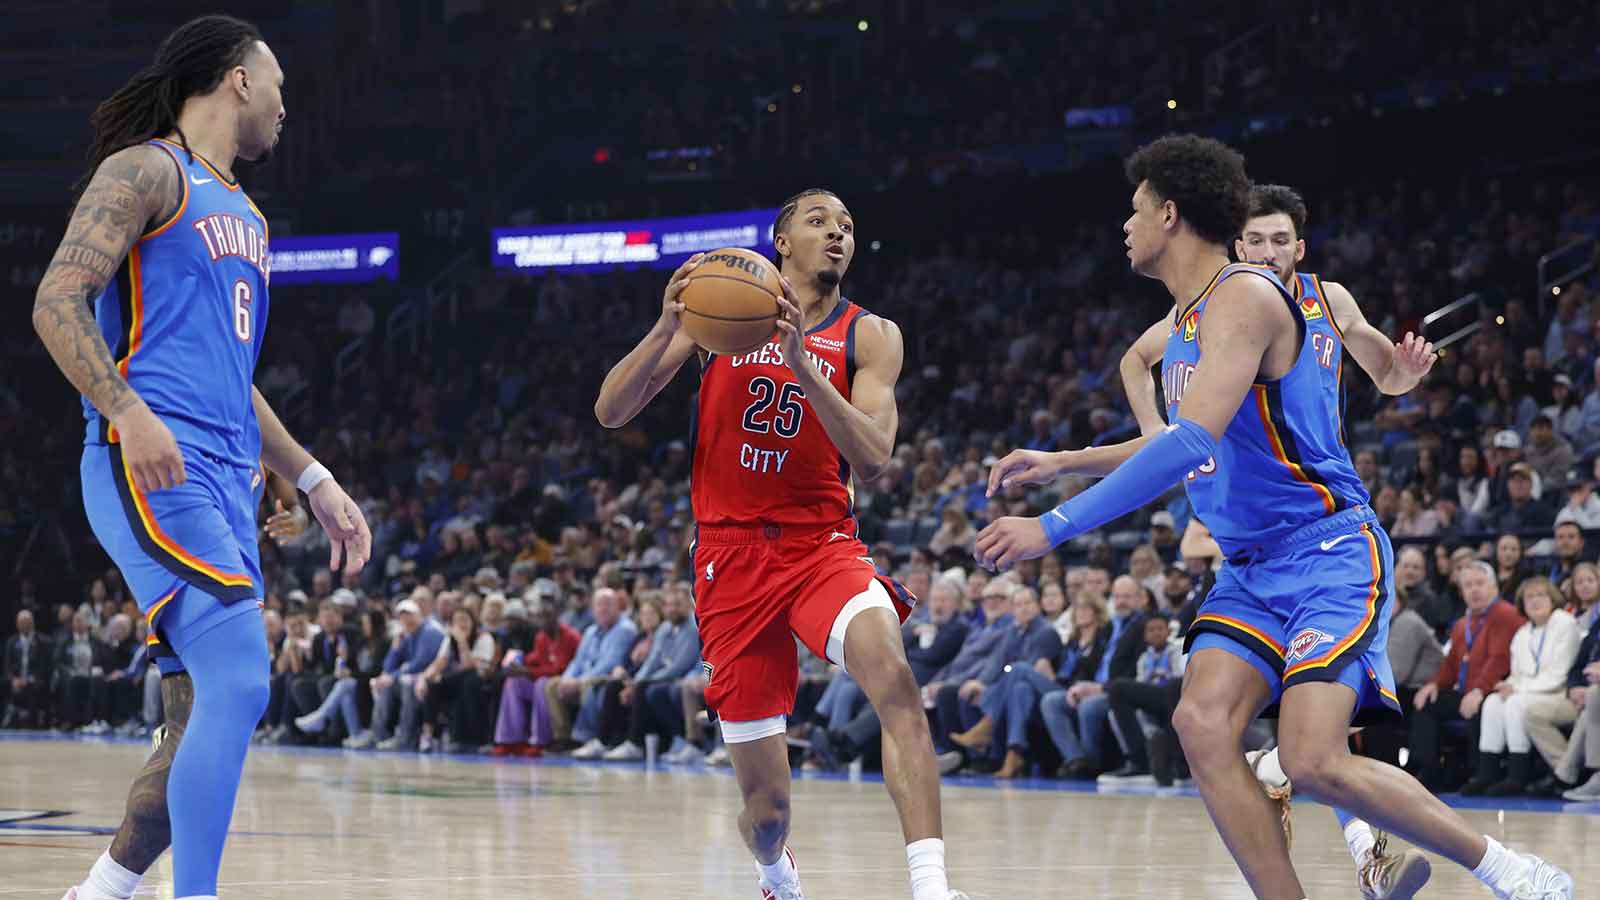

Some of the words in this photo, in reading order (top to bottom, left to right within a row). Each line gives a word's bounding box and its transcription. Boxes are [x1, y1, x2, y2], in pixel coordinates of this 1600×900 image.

[700, 254, 765, 280] Wilson
[234, 278, 252, 342] 6
[810, 335, 845, 348] NEWAGE
[732, 342, 836, 382] CRESNT
[742, 376, 806, 438] 25
[740, 443, 789, 473] CITY
